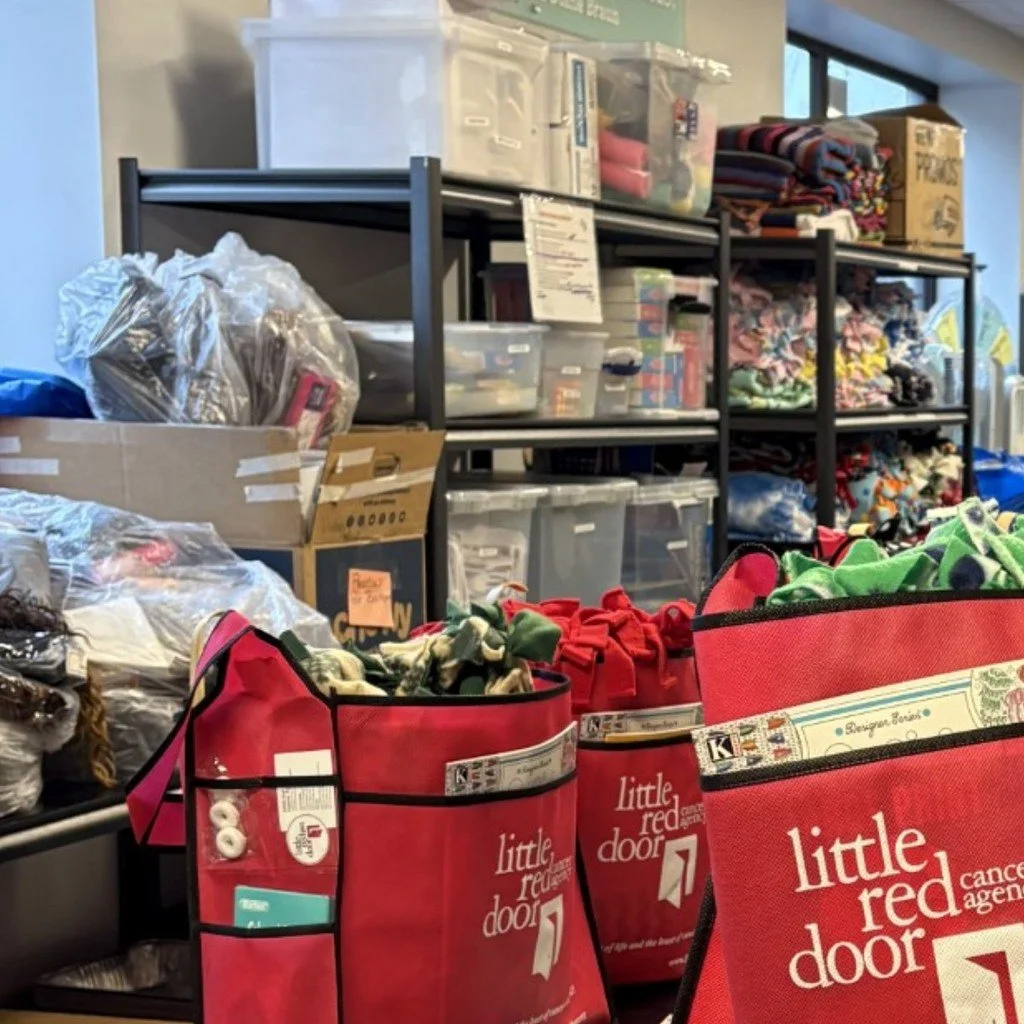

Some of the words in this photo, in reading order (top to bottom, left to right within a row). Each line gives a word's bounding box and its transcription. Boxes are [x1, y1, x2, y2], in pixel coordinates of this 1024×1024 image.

[844, 716, 891, 738] Designer
[614, 771, 673, 811] little
[639, 794, 680, 836] red
[495, 827, 552, 875] little
[597, 827, 665, 863] door
[786, 811, 928, 893] little
[516, 852, 555, 901] red
[858, 850, 962, 933] red
[482, 894, 540, 938] door
[788, 923, 926, 989] door
